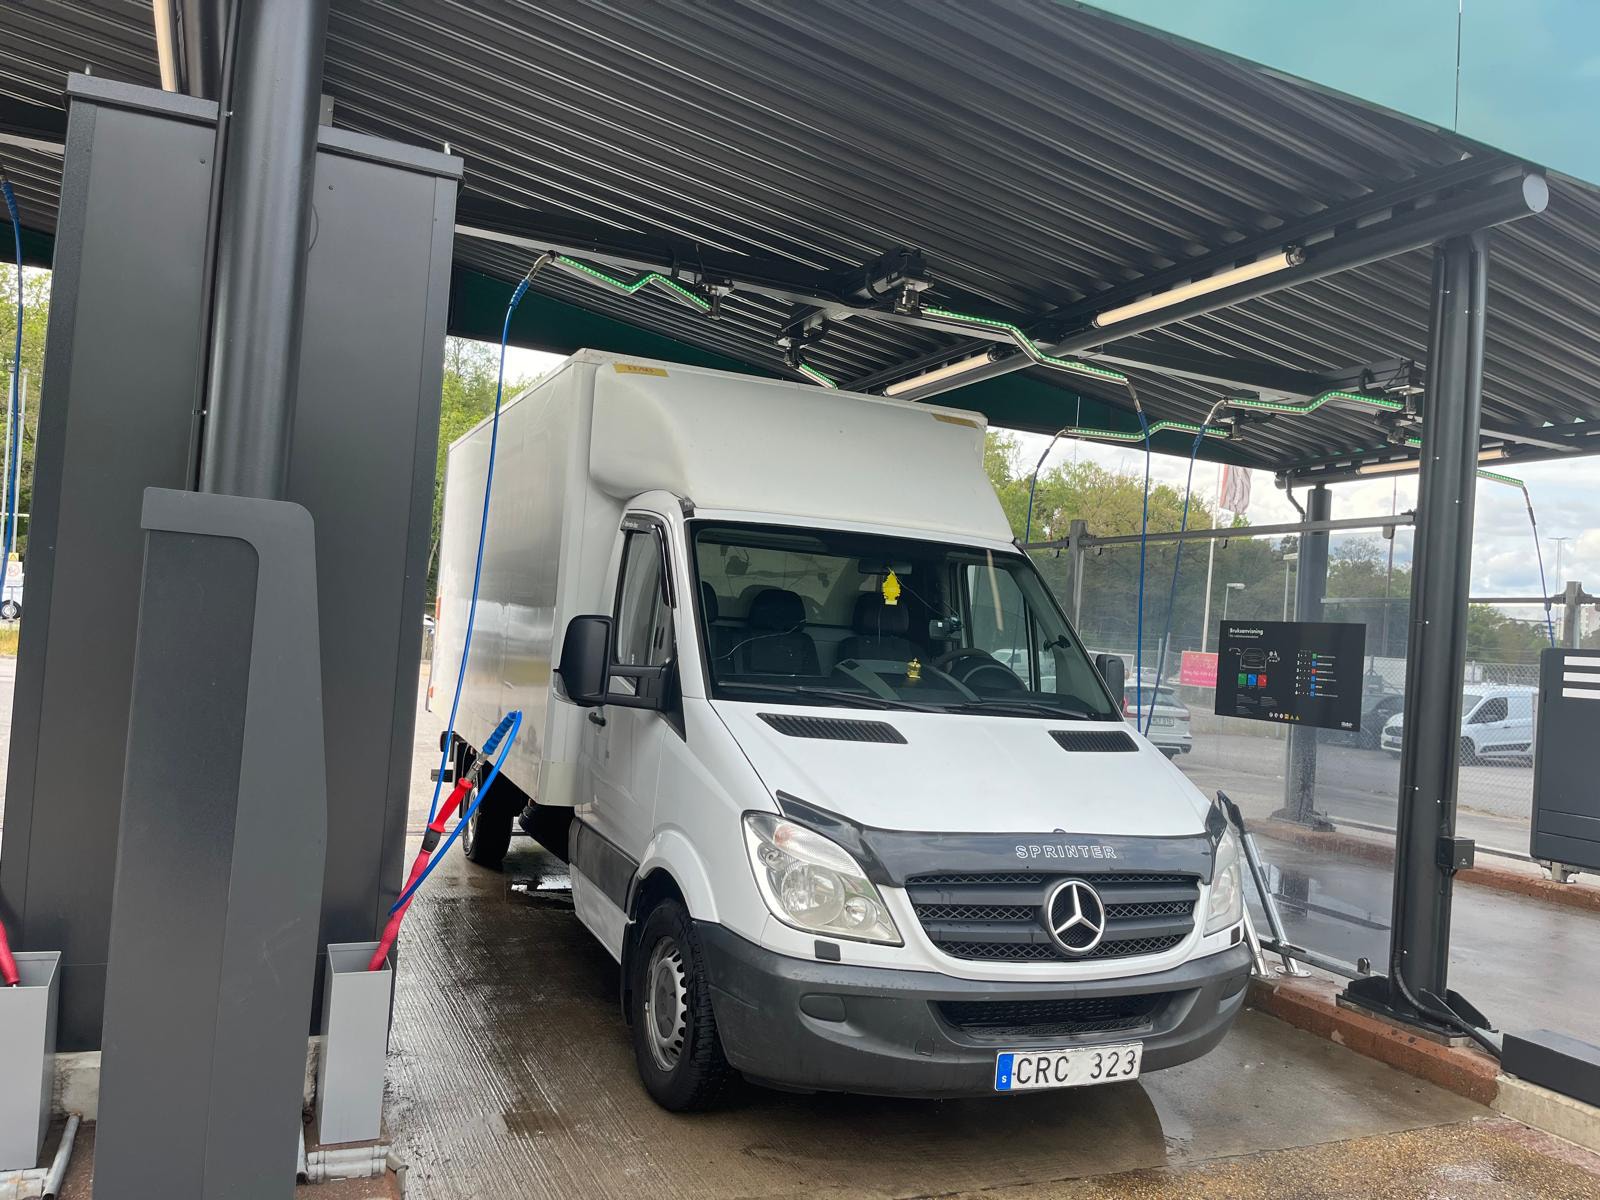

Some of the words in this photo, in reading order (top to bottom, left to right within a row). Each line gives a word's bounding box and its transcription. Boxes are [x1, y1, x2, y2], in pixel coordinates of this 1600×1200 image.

[1015, 845, 1117, 859] SPRINTER
[1001, 1075, 1007, 1083] S
[1017, 1056, 1070, 1085] CRC
[1090, 1050, 1137, 1079] 323
